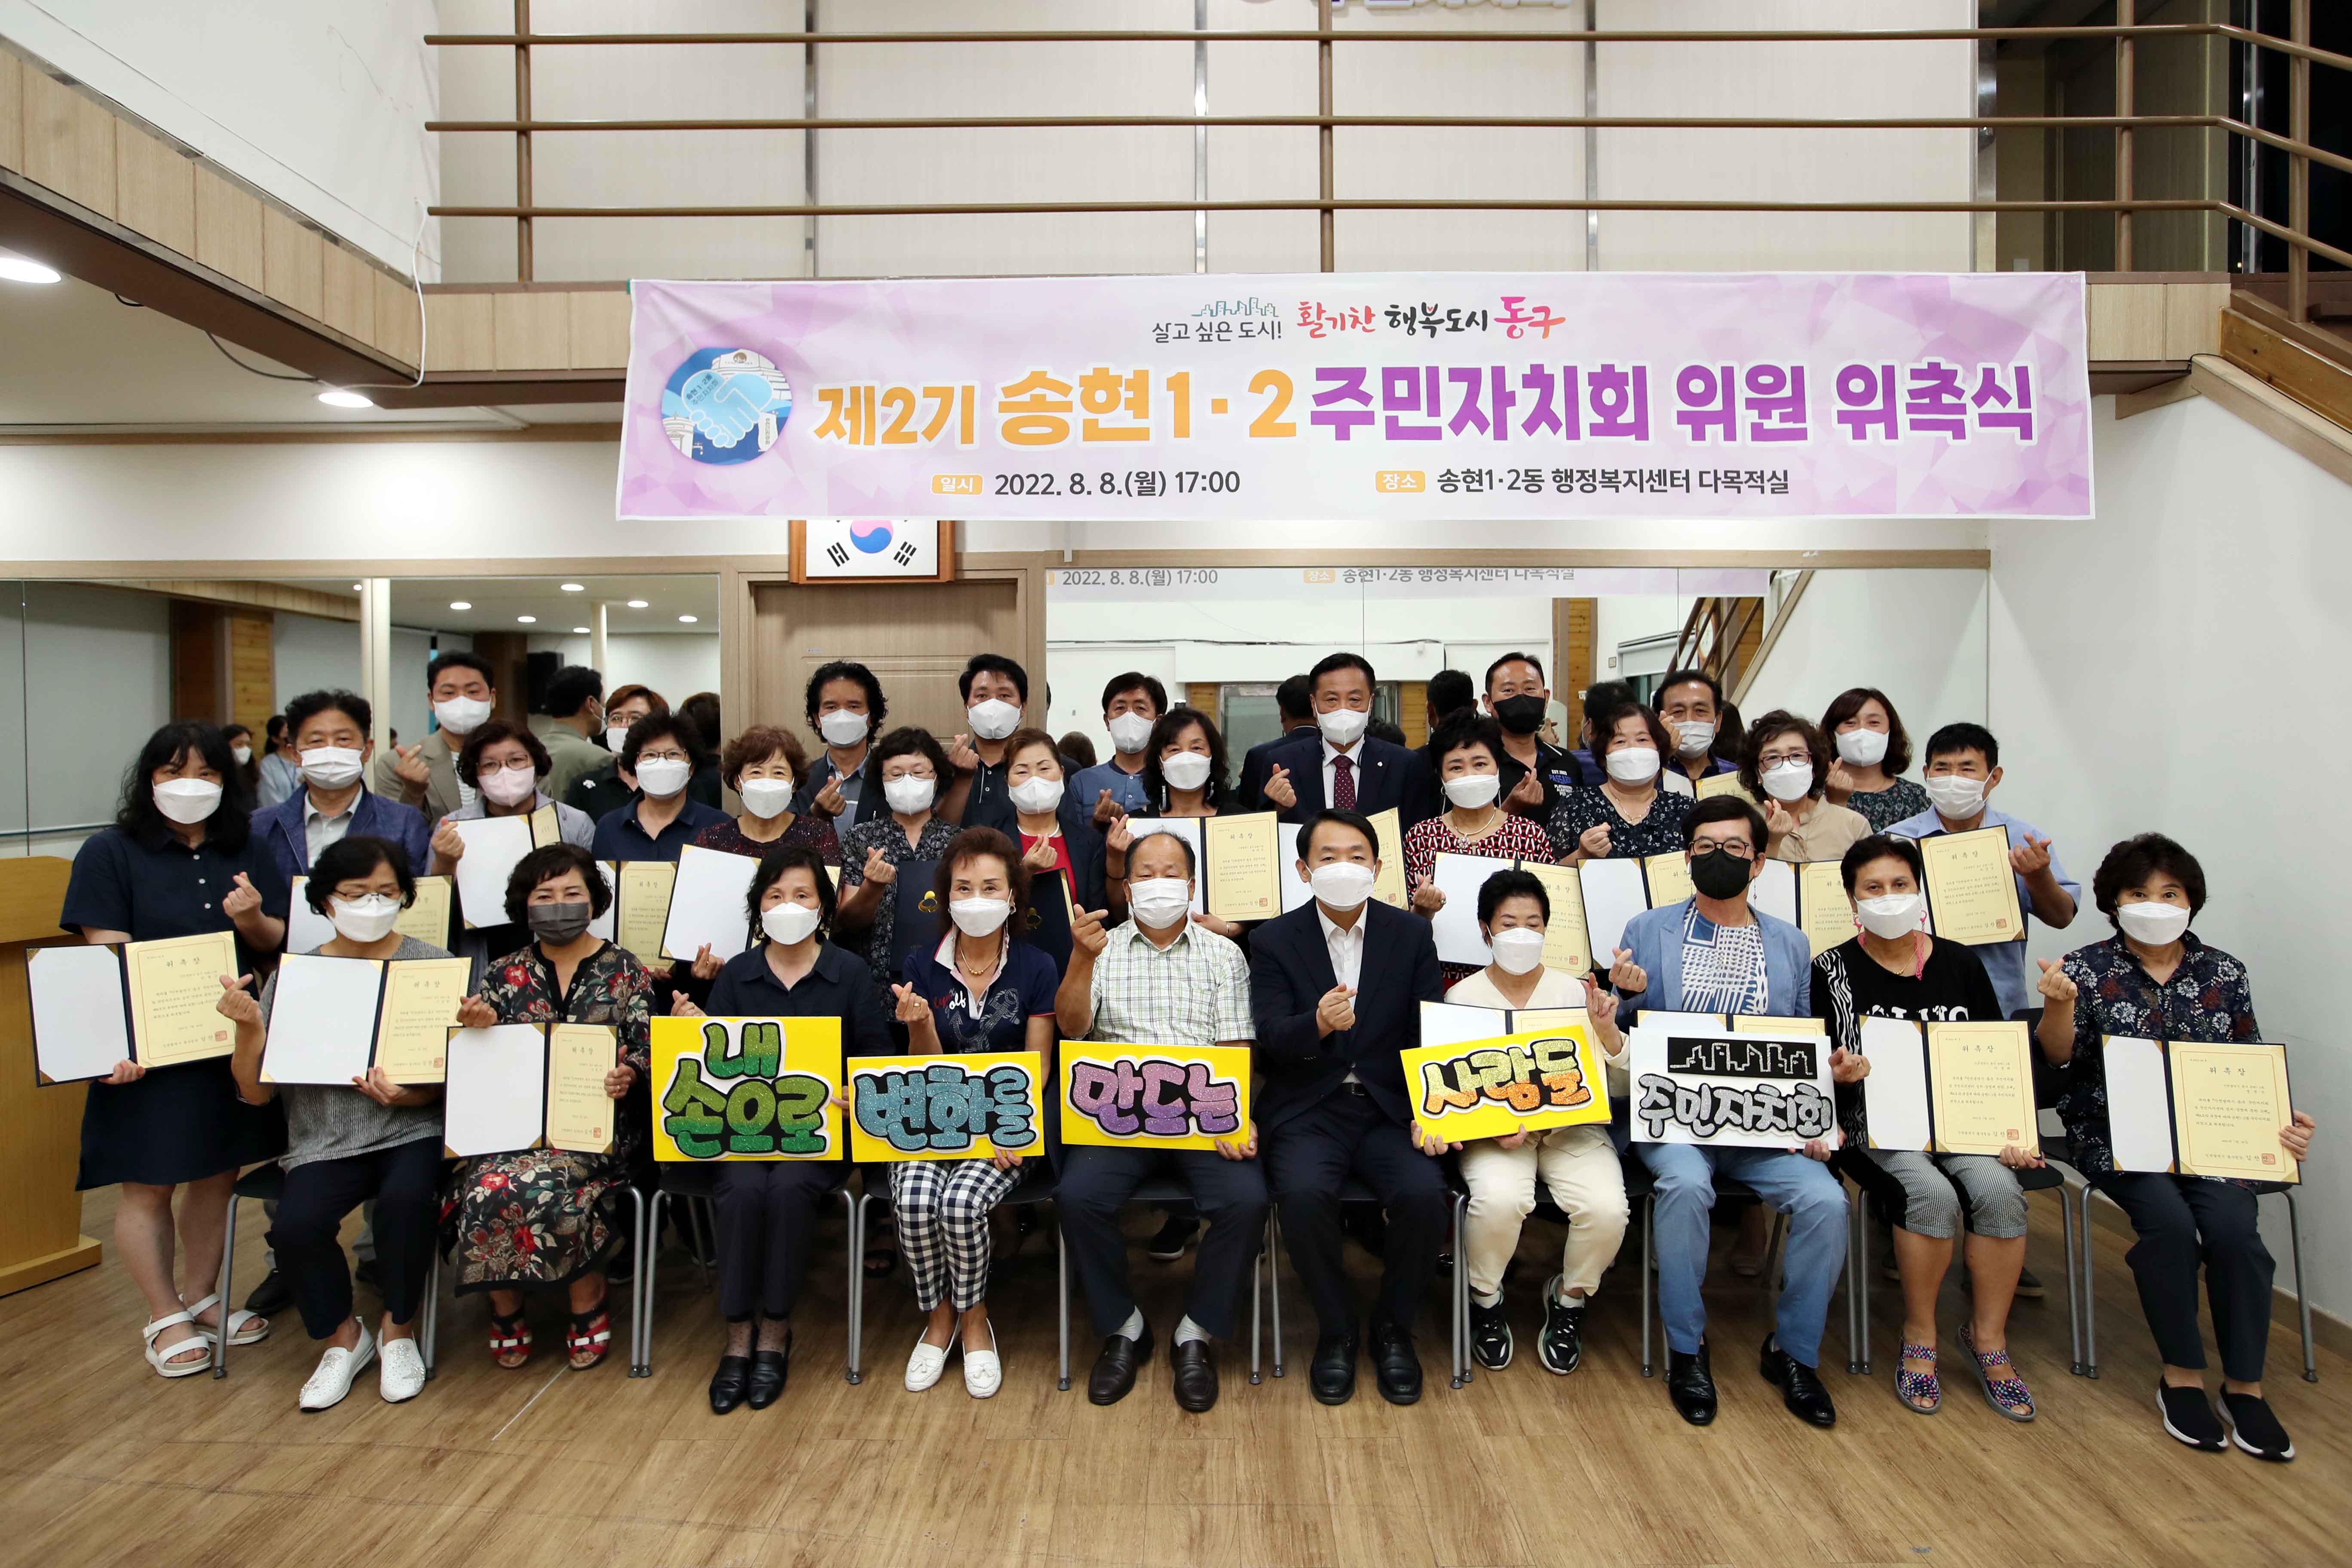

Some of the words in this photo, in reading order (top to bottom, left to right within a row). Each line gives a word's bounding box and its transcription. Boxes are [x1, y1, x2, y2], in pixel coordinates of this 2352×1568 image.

[1152, 322, 1190, 343] 살고
[1196, 321, 1232, 342] 싶은
[1239, 320, 1281, 340] 도시!
[1297, 301, 1376, 339] 활기찬
[1384, 302, 1488, 338] 행복도시
[1494, 296, 1566, 339] 동구
[814, 385, 974, 446] 제2기
[1311, 364, 1648, 441] 주민자치회
[1677, 364, 1807, 441] 위원
[1836, 362, 2033, 440] 위촉식
[940, 477, 974, 493] 일시
[995, 473, 1062, 496] 2022.
[1069, 473, 1092, 495] 8.
[1175, 471, 1240, 493] 17:00
[1381, 473, 1417, 490] 장소
[1551, 468, 1690, 494] 행정복지센터
[1698, 469, 1789, 495] 다목적실
[1062, 570, 1105, 585] 2022.
[1176, 570, 1218, 584] 17:00
[1308, 570, 1332, 581] 장소
[704, 1022, 781, 1079] 내
[662, 1058, 831, 1158] 손으로
[854, 1066, 1037, 1151] 변화를
[1070, 1060, 1239, 1135] 만드는
[1638, 1073, 1834, 1139] 주민자치회
